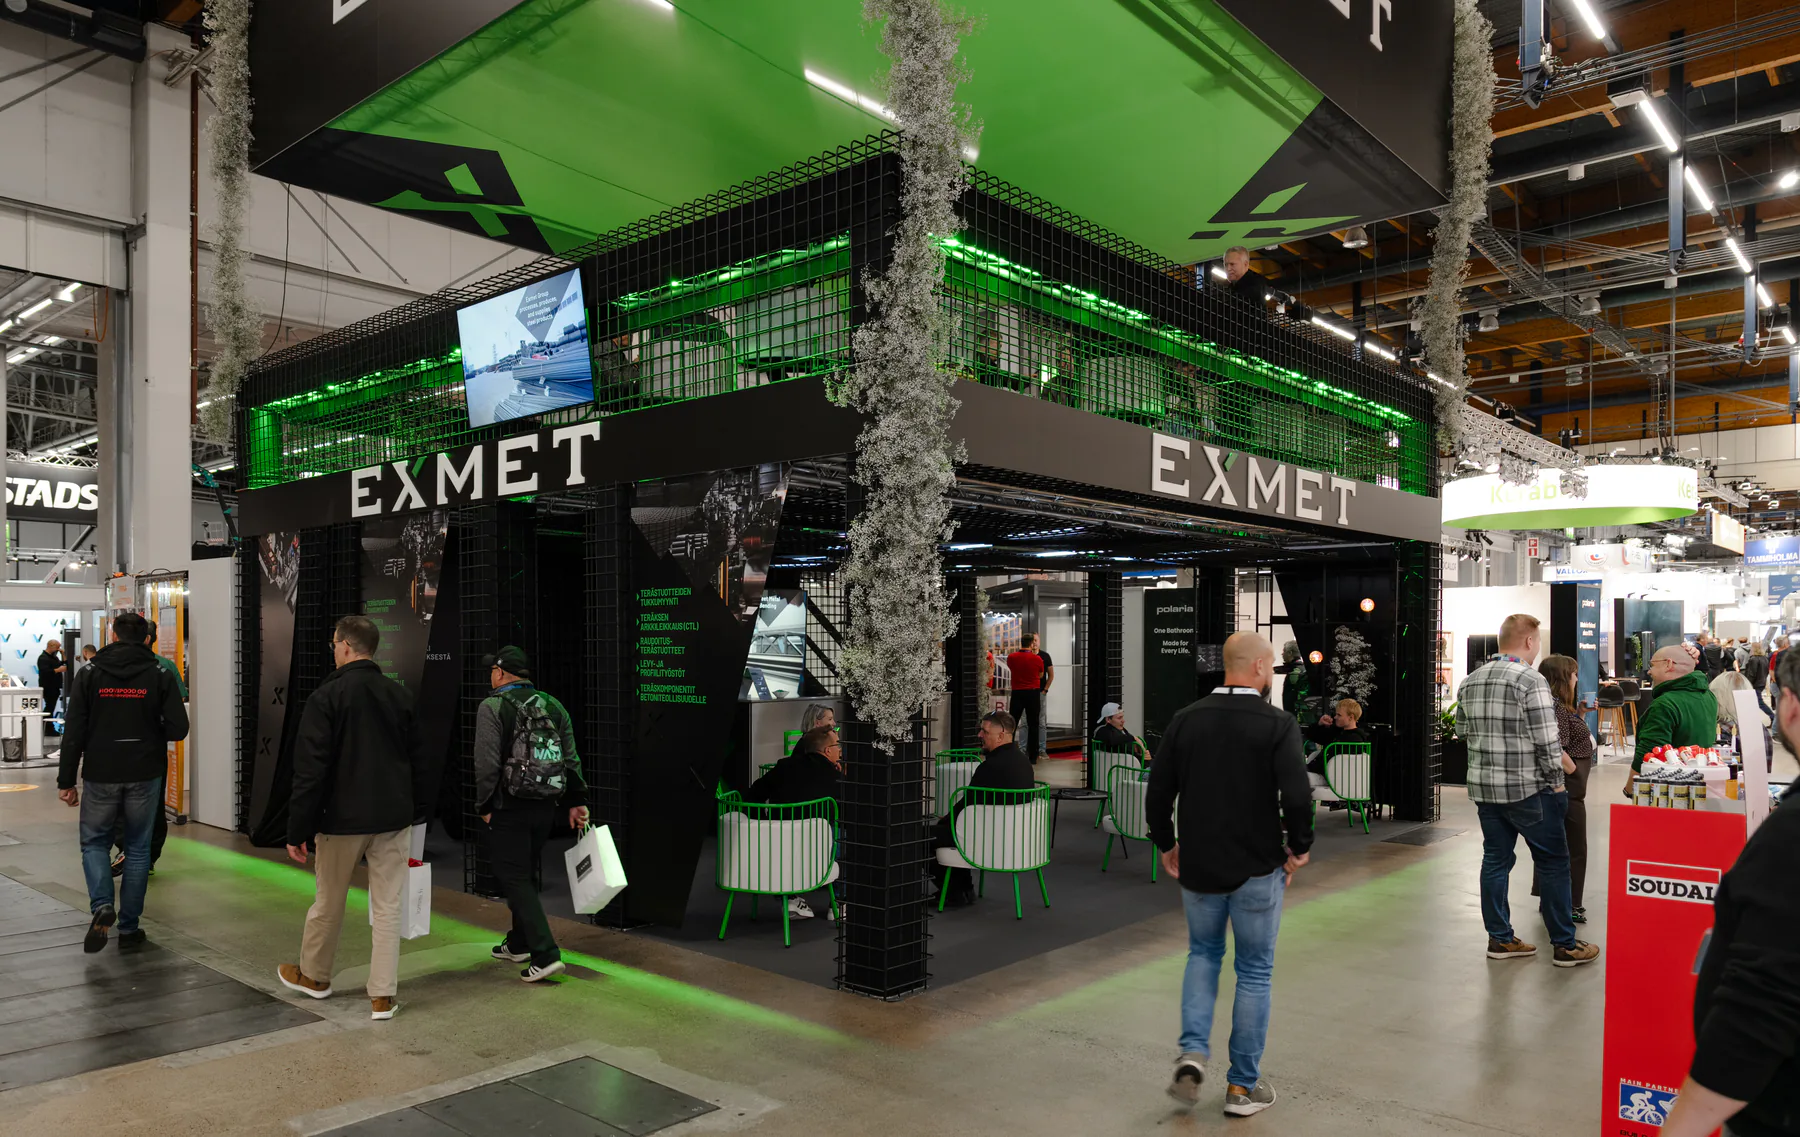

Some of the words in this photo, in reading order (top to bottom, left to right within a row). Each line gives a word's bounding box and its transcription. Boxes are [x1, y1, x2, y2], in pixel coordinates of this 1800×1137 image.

[352, 421, 600, 518] EXMET
[1152, 432, 1356, 526] EXMET
[640, 587, 692, 598] TERÄSTUOTTEIDEN
[640, 597, 679, 607] TUKKUMYYNTI
[1156, 604, 1194, 616] polaria
[640, 612, 669, 622] TERÄKSEN
[640, 637, 673, 645] RAUDOITUS-
[640, 645, 686, 655] TERÄSTUOTTEET
[1161, 647, 1177, 656] Every
[640, 682, 696, 694] TERÄSKOMPONENTIT
[1628, 877, 1715, 901] SOUDAL
[1620, 1077, 1641, 1087] MAIN
[1645, 1082, 1679, 1094] PARTNE
